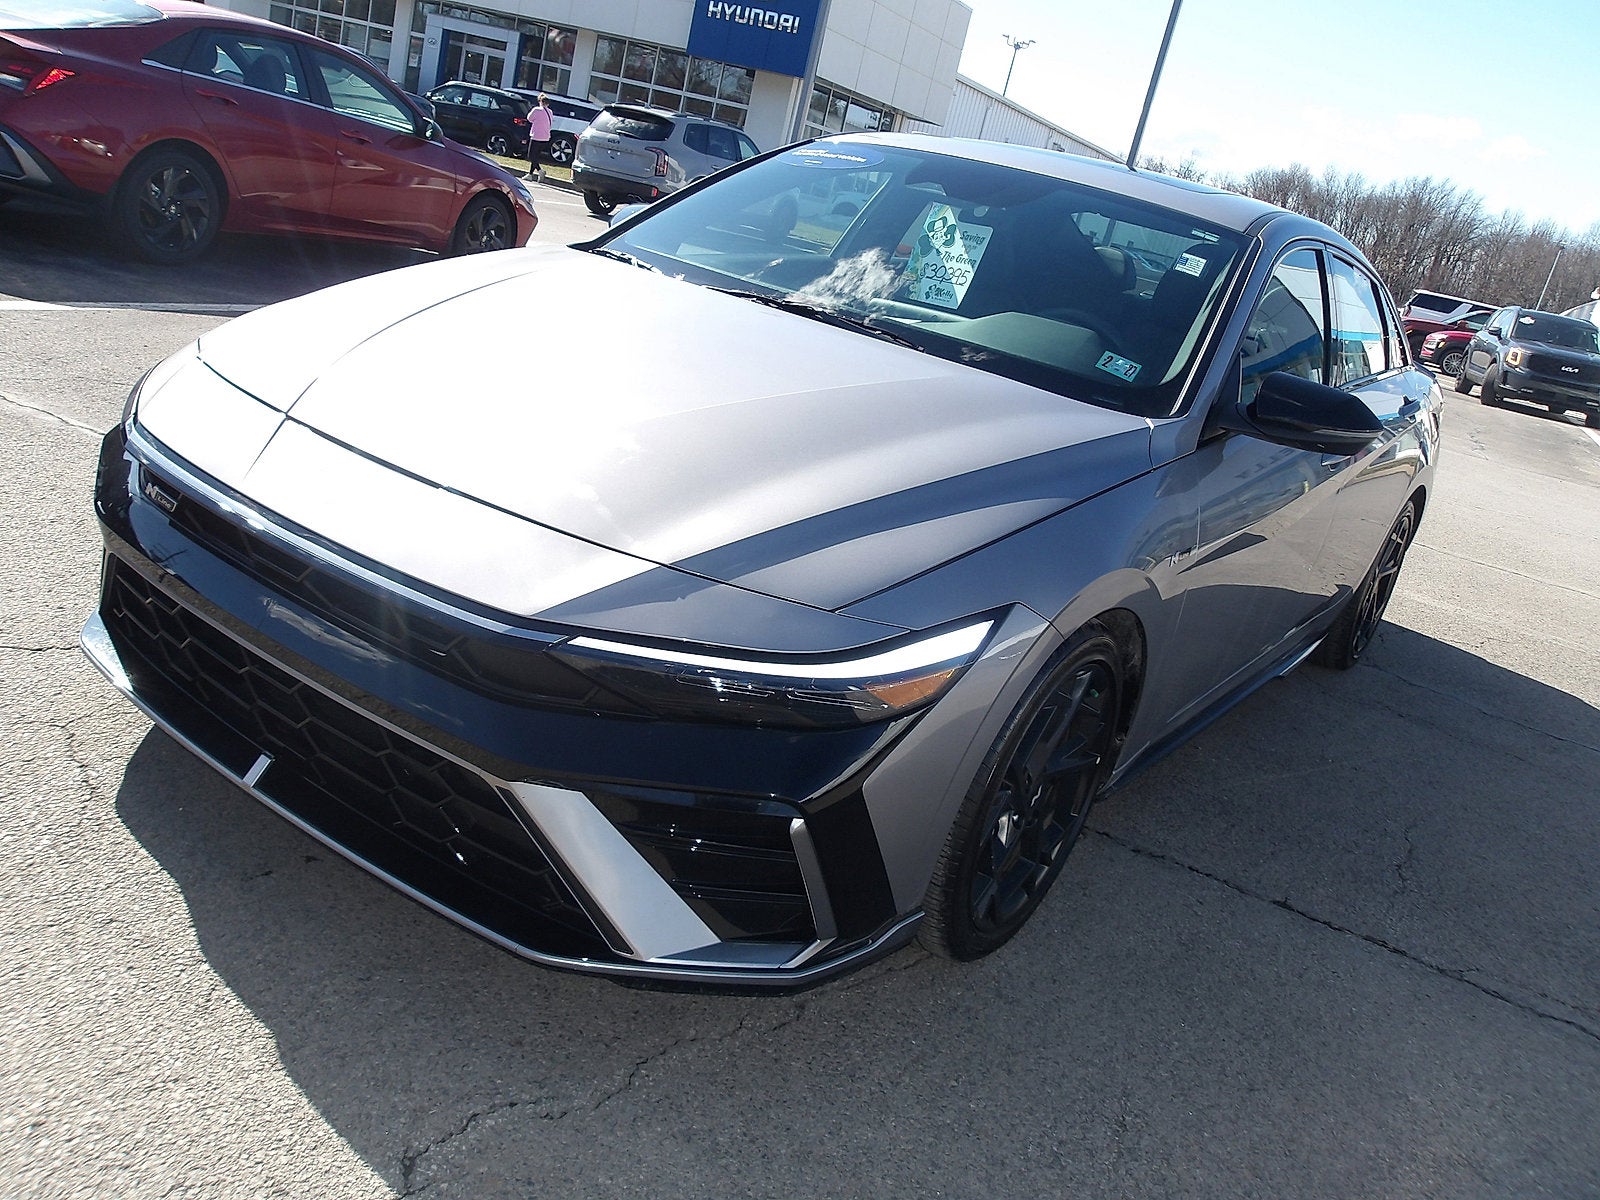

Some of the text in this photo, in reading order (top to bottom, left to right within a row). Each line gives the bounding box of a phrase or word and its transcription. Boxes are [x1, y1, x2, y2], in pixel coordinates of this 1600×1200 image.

[707, 0, 800, 34] HYUNDAI
[960, 230, 986, 245] Saving
[942, 251, 977, 267] The Green
